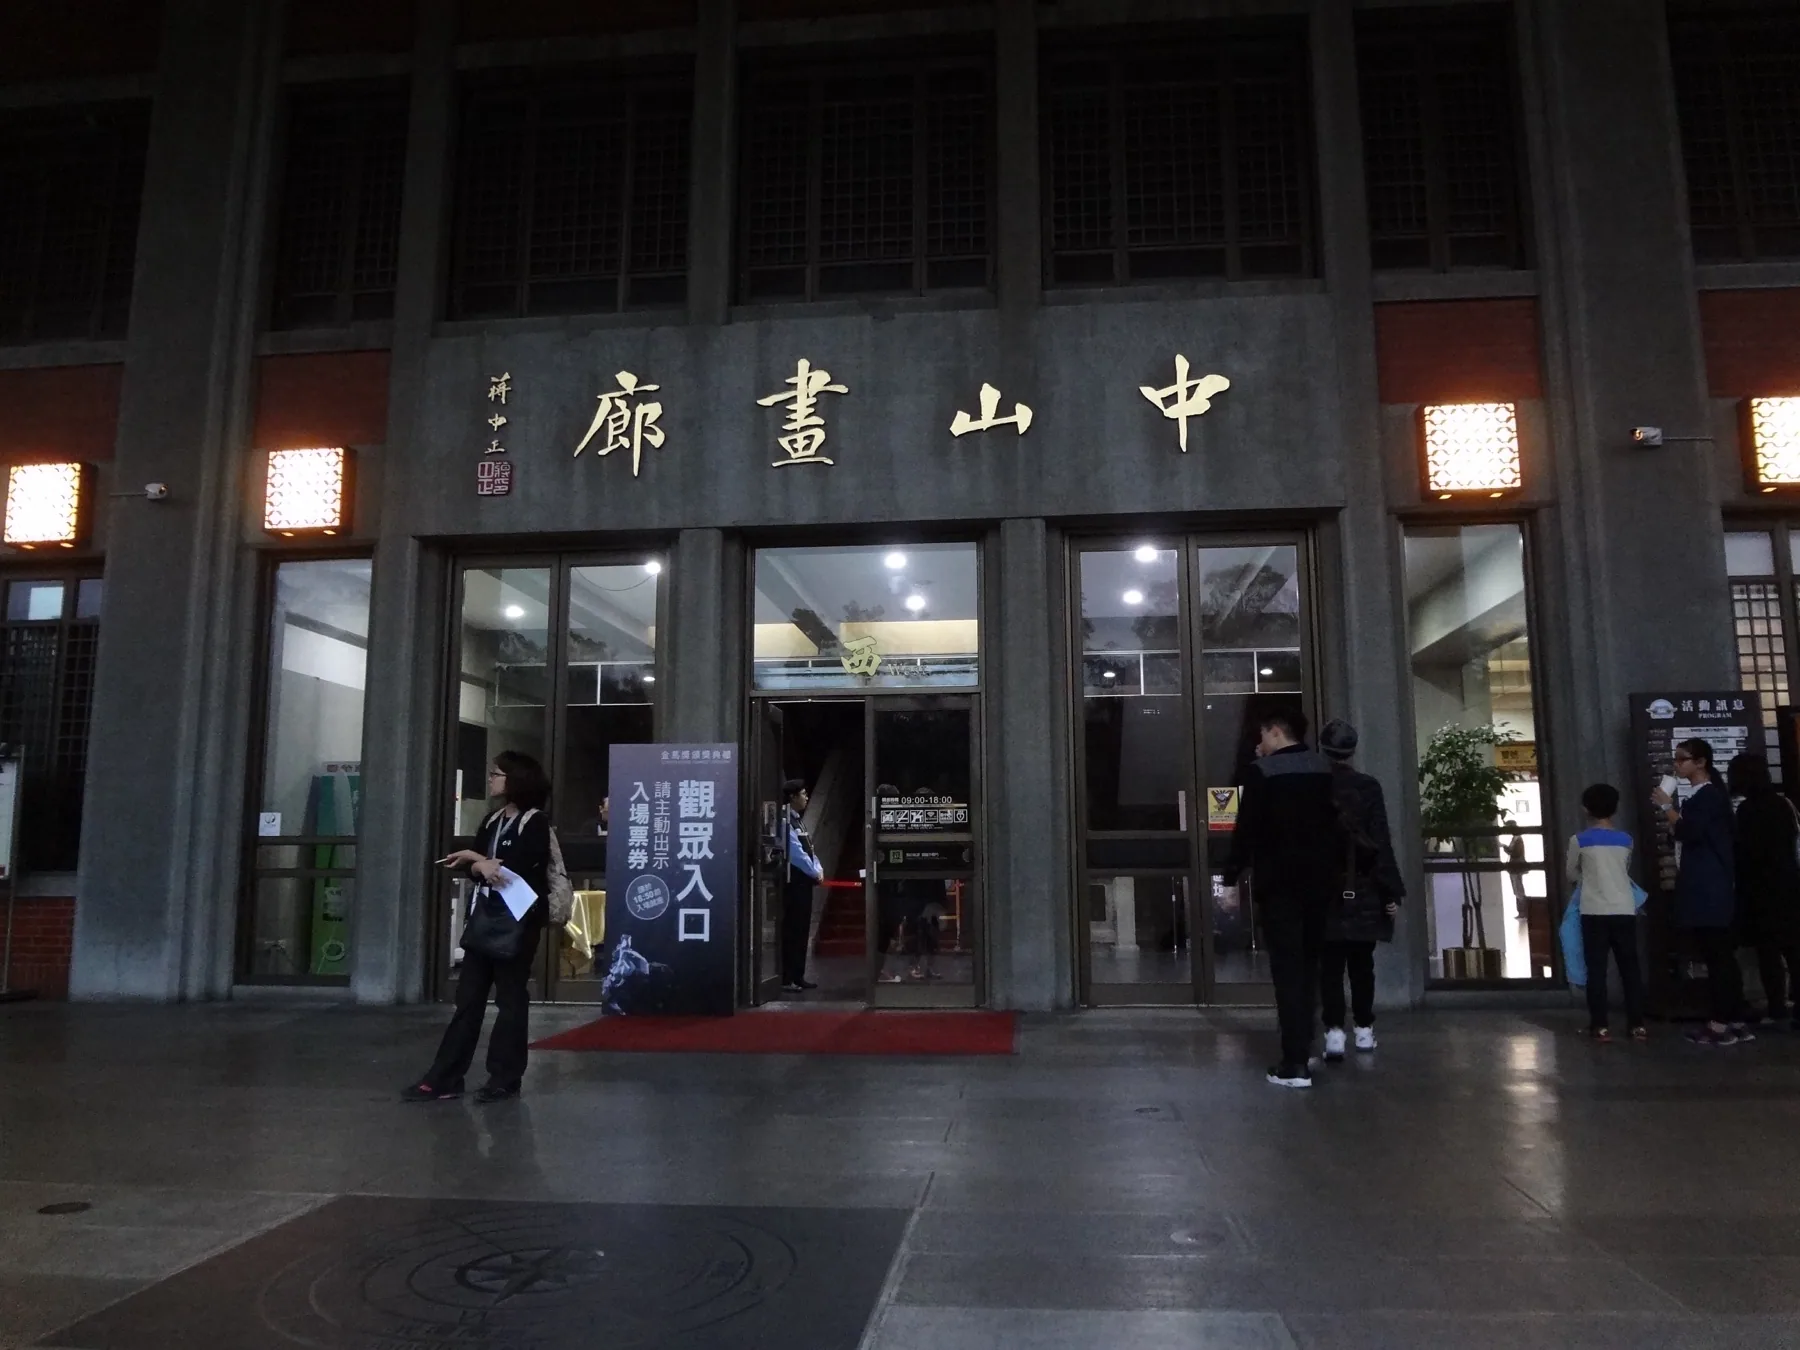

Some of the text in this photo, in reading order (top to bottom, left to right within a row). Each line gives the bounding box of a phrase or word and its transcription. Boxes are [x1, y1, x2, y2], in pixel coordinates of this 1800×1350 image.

[484, 371, 512, 454] 蔣中正
[841, 636, 882, 677] 西
[1681, 698, 1745, 712] 活動訊息
[627, 781, 650, 870] 入場票券
[653, 781, 672, 869] 請主動出示
[901, 796, 952, 805] 09:00-18:00
[677, 780, 716, 943] 觀眾入口
